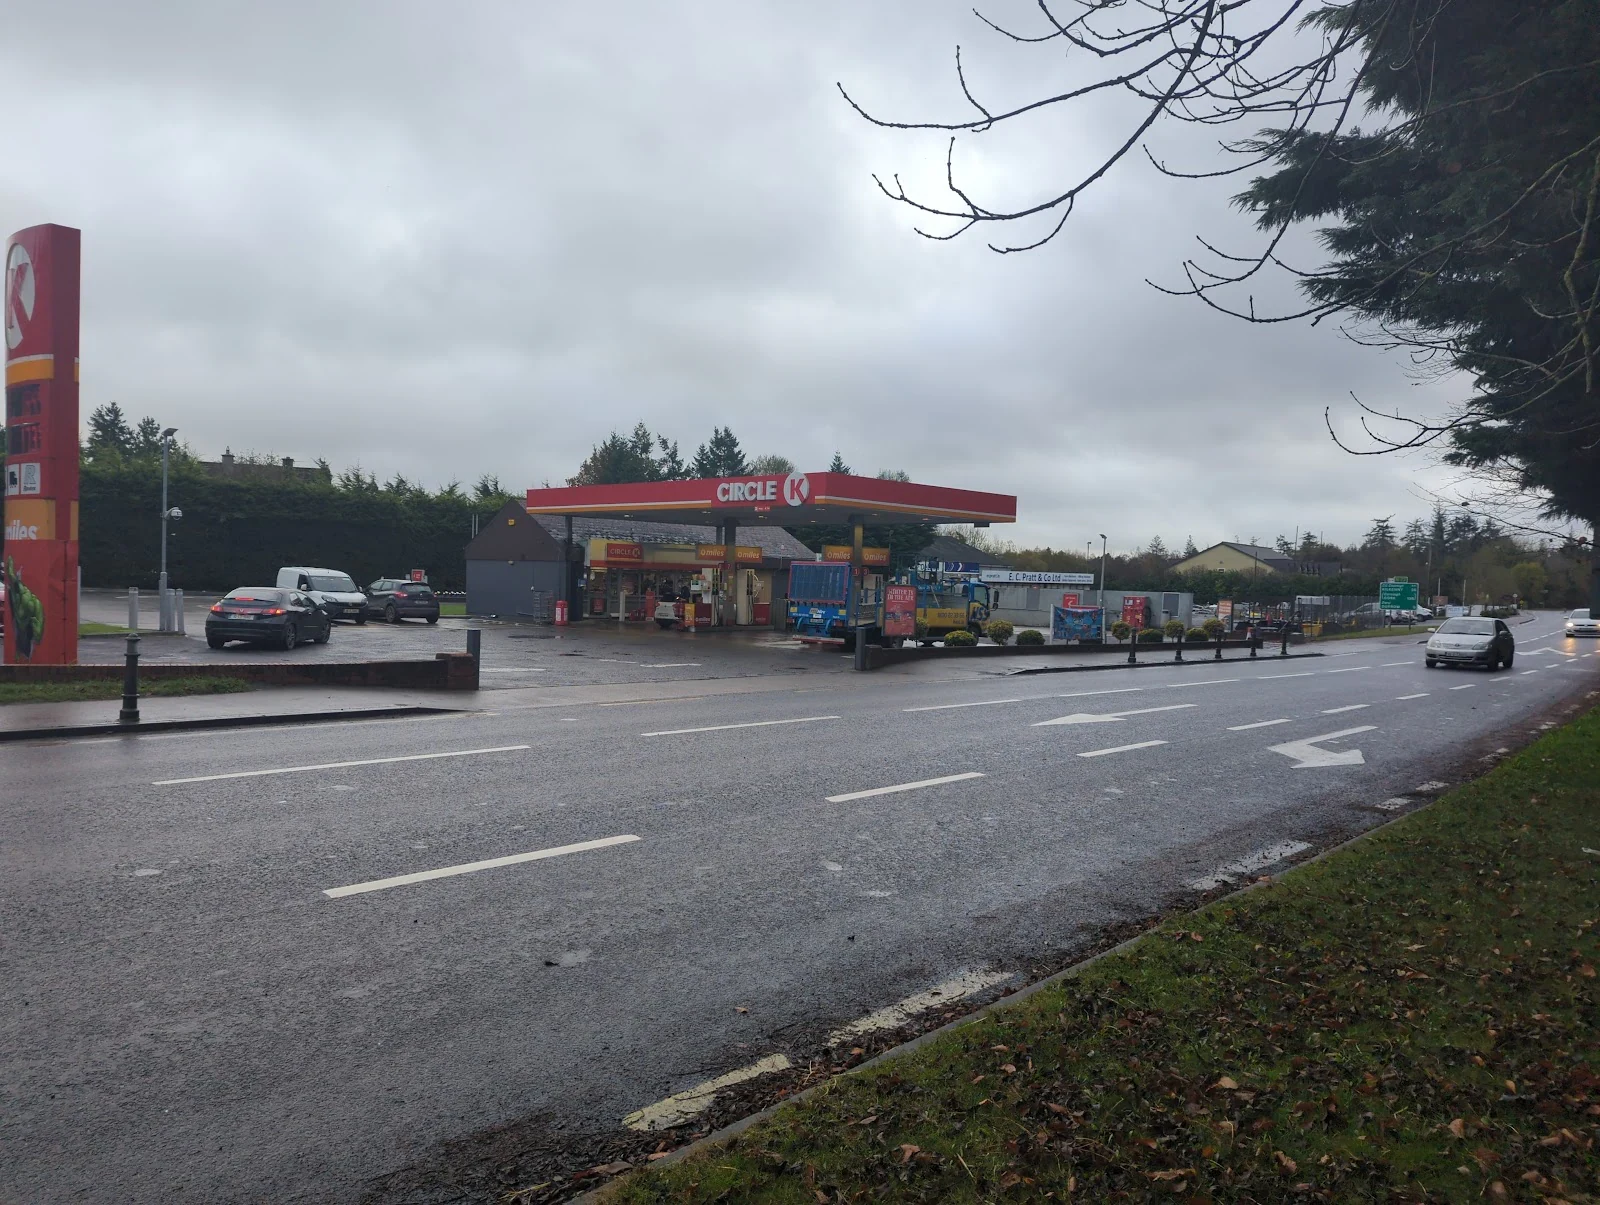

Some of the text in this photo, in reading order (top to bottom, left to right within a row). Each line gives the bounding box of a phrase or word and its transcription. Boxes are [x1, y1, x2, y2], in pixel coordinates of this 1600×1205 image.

[717, 478, 806, 503] CIRCLE K
[610, 548, 632, 556] CIRCLE
[1008, 572, 1014, 581] E.
[1015, 572, 1021, 581] C.
[1022, 573, 1037, 582] Pratt
[1038, 573, 1042, 582] &
[1043, 573, 1052, 582] Co
[1053, 574, 1061, 582] Ltd
